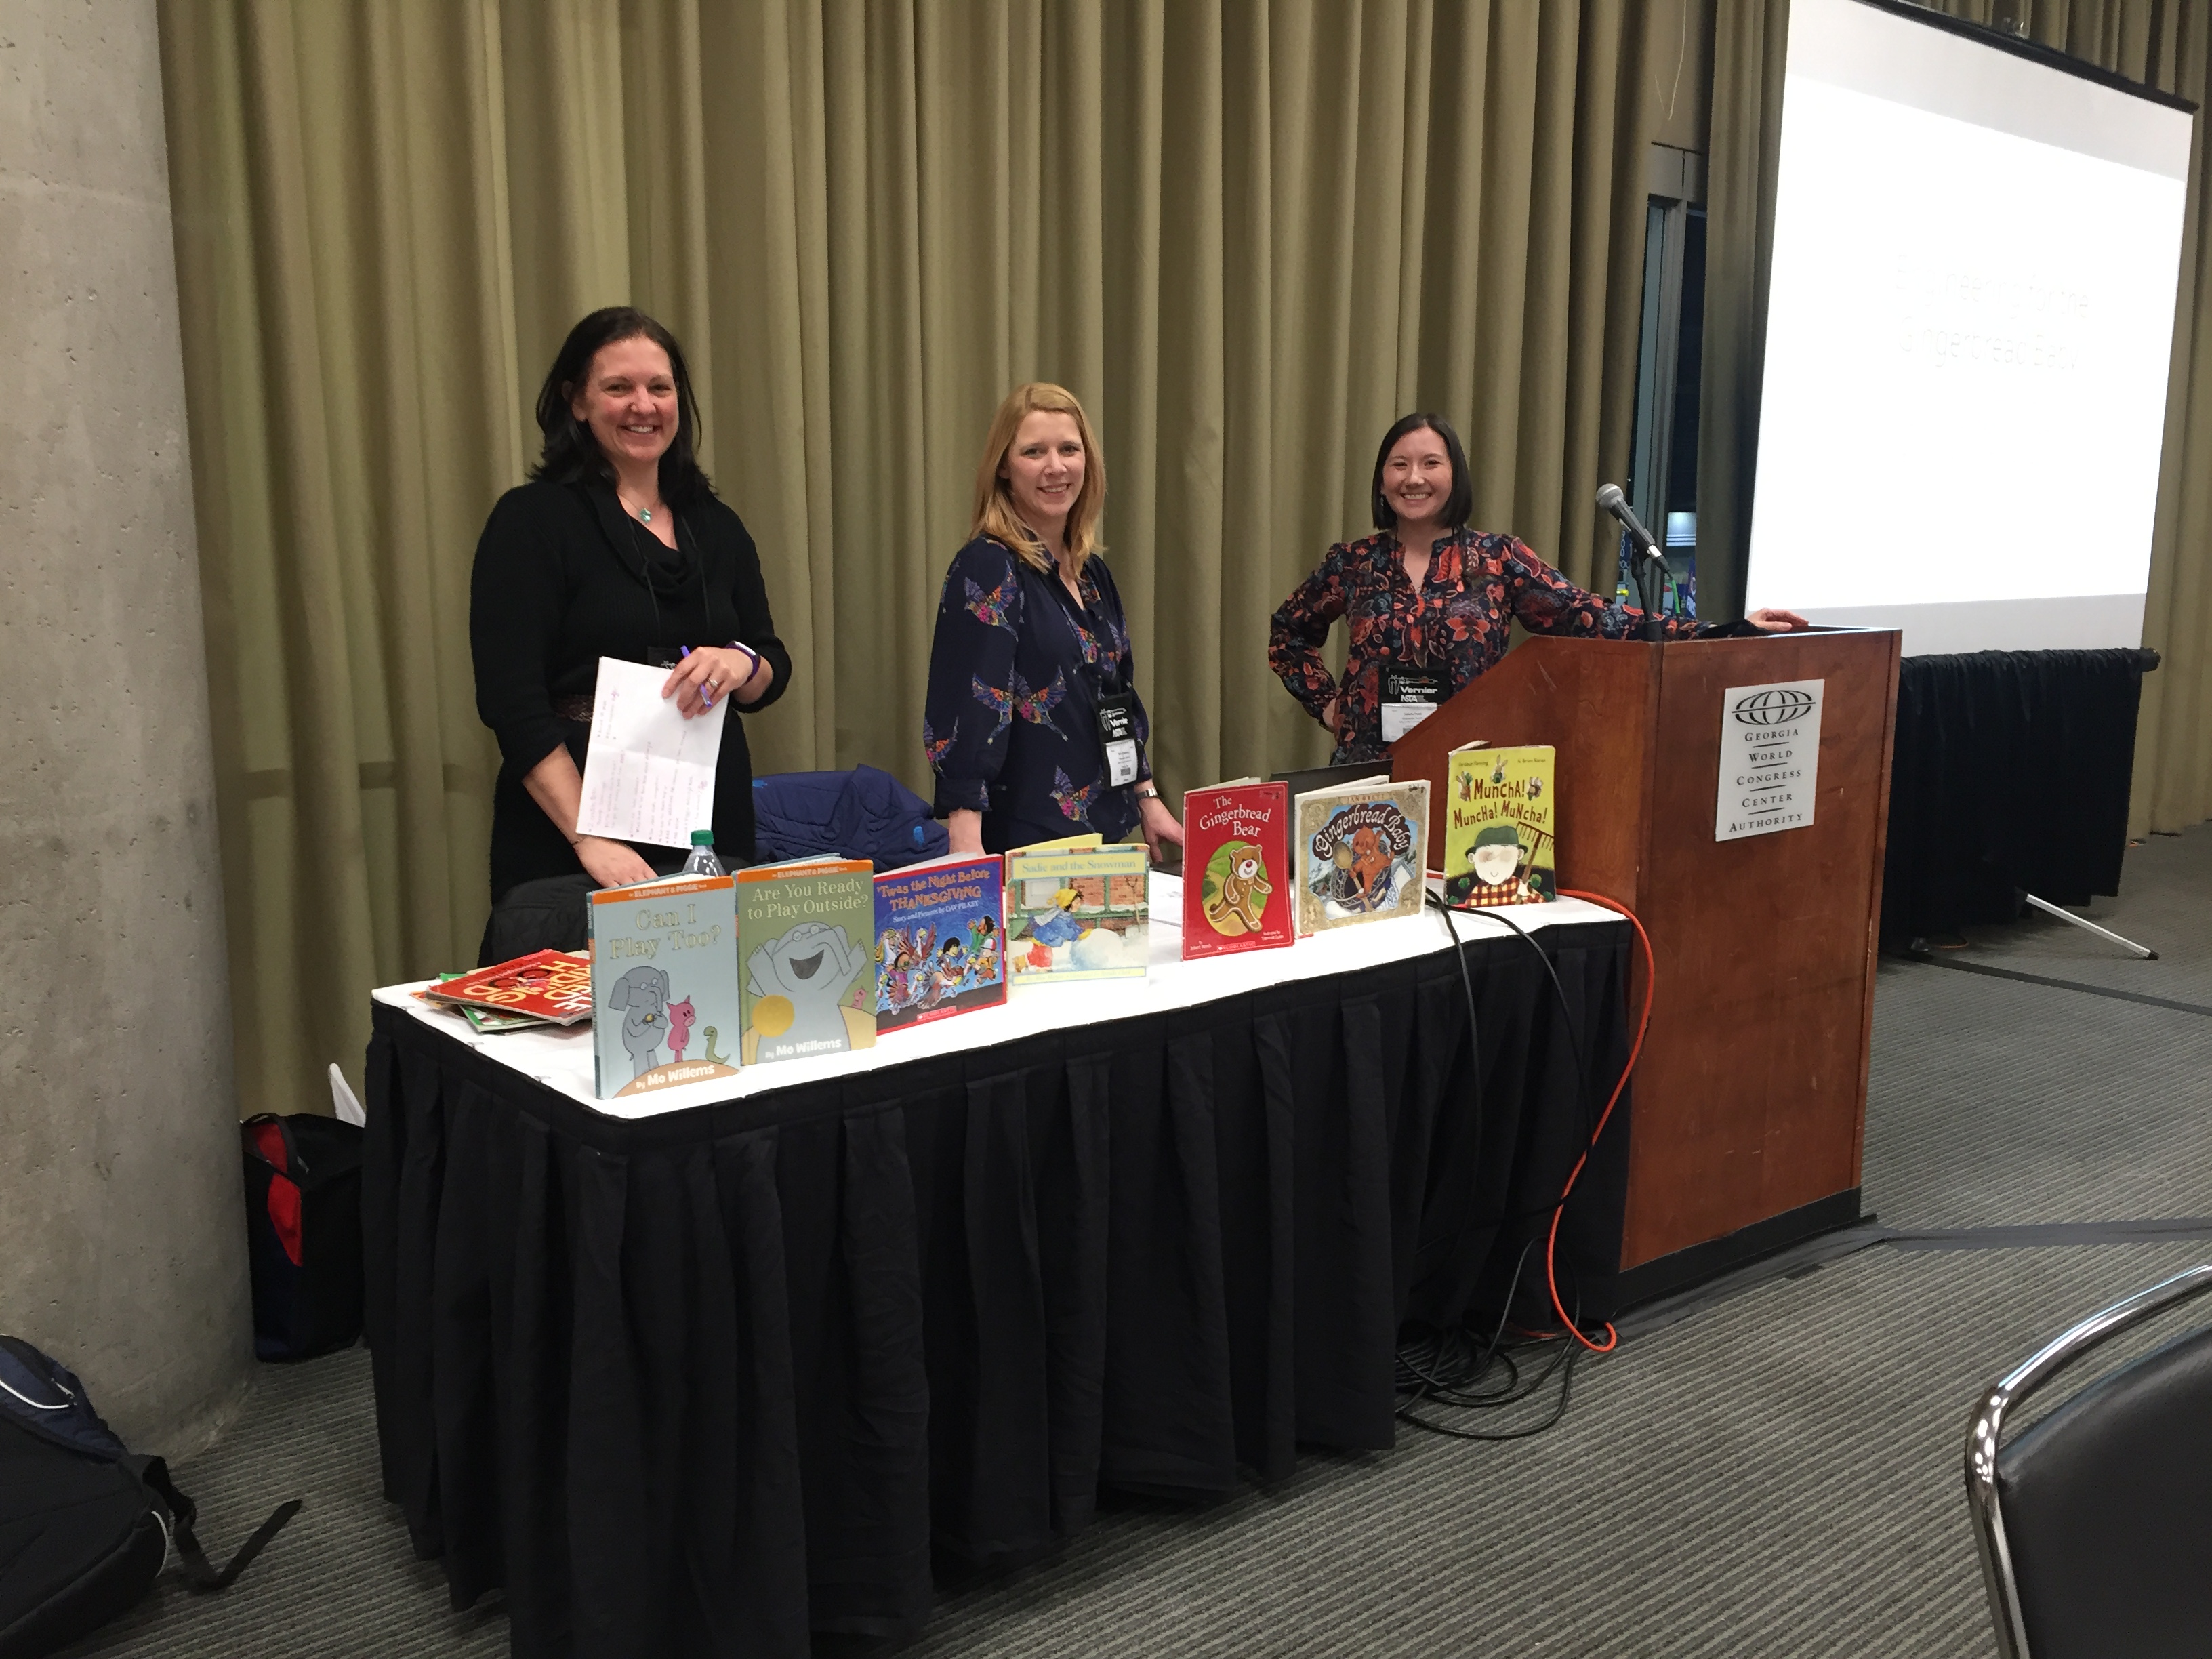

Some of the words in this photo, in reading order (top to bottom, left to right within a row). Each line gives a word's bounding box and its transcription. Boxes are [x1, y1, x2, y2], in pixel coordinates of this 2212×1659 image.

[1399, 686, 1438, 694] Vernier
[1745, 729, 1799, 741] GEORGIA
[1749, 750, 1793, 762] WORLD
[1736, 770, 1801, 785] CONGRESS
[1213, 794, 1232, 810] The
[1742, 794, 1793, 808] CENTER
[1199, 805, 1271, 832] Gingerbread
[1729, 813, 1803, 832] AUTHORITY
[1233, 821, 1261, 838] Bear
[1315, 804, 1392, 859] Gingerbread
[1383, 813, 1412, 850] Baby
[1021, 859, 1049, 874] Sadie
[1050, 859, 1067, 872] and
[1069, 859, 1084, 871] the
[1086, 858, 1136, 870] Snowman
[910, 880, 927, 891] the
[928, 873, 956, 888] Night
[958, 869, 990, 882] Before
[752, 886, 781, 902] Are
[783, 884, 815, 899] You
[817, 879, 865, 897] Ready
[889, 886, 981, 911] THANKSGIVING
[636, 909, 680, 930] Can
[686, 903, 698, 924] I
[747, 905, 764, 920] to
[766, 901, 802, 920] Play
[803, 894, 869, 915] Outside?
[609, 935, 662, 960] Play
[668, 925, 722, 951] Too?
[776, 1042, 794, 1057] Mo
[795, 1038, 842, 1054] Willems
[647, 1069, 665, 1086] Mo
[667, 1064, 715, 1083] Willems
